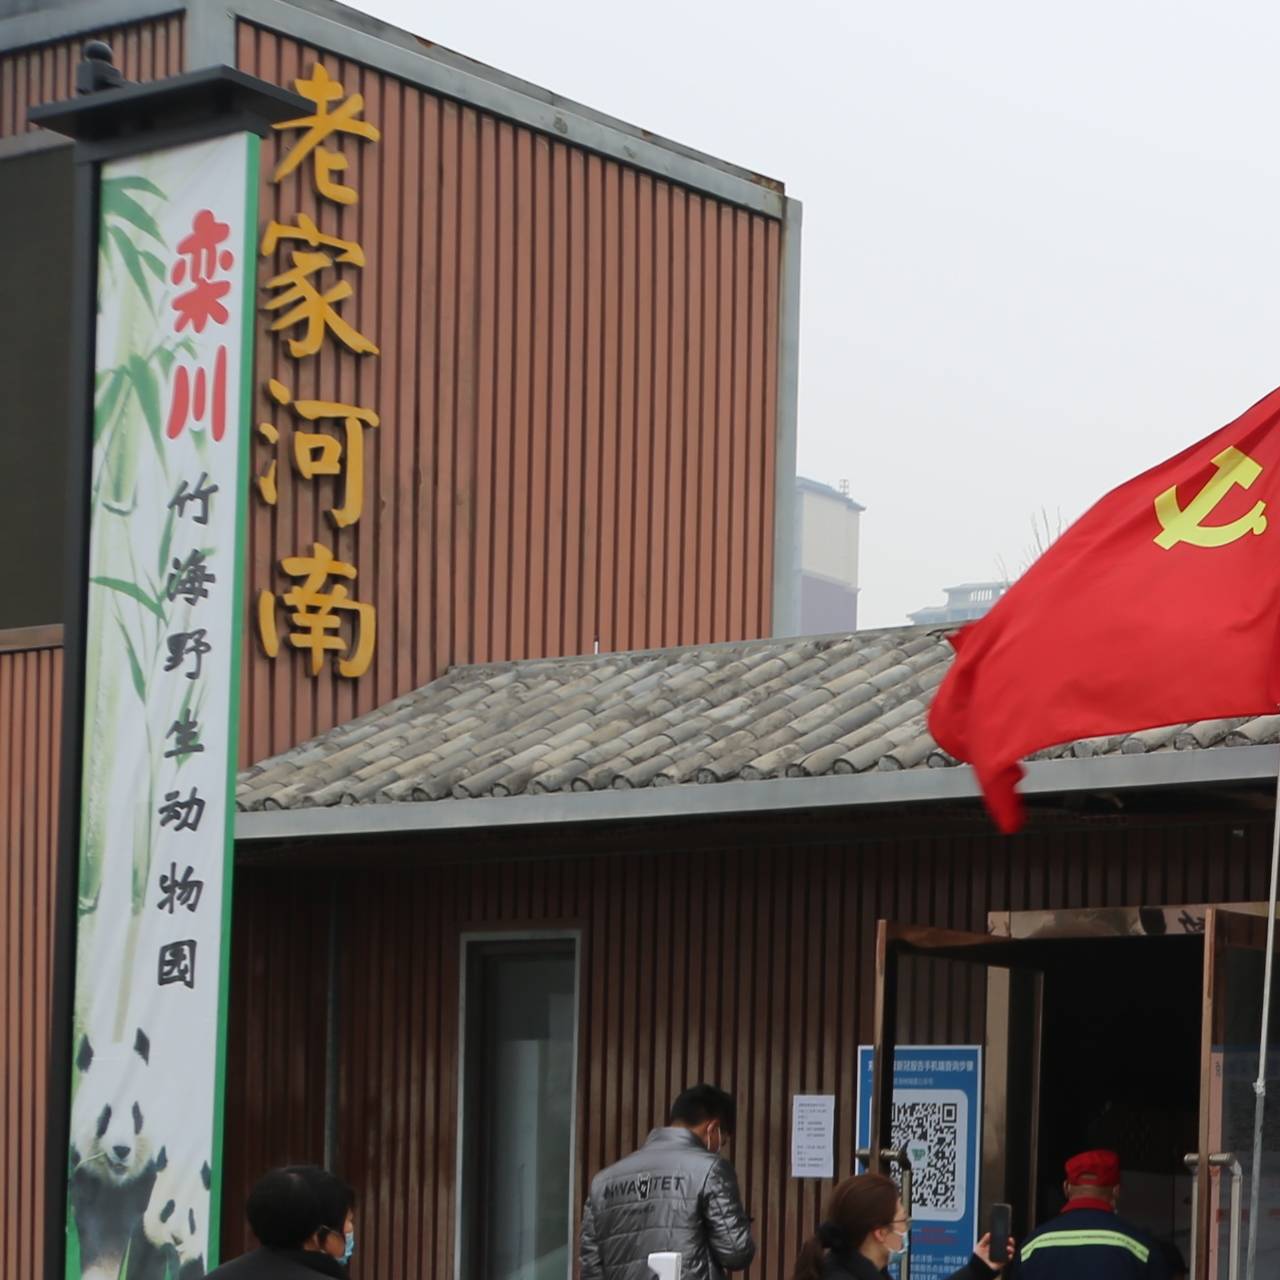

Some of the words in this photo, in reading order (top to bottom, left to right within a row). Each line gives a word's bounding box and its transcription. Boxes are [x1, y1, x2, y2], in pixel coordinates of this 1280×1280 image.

[166, 208, 235, 443] 栾川
[258, 62, 380, 679] 老家河南
[157, 472, 219, 989] 竹海野生动物园
